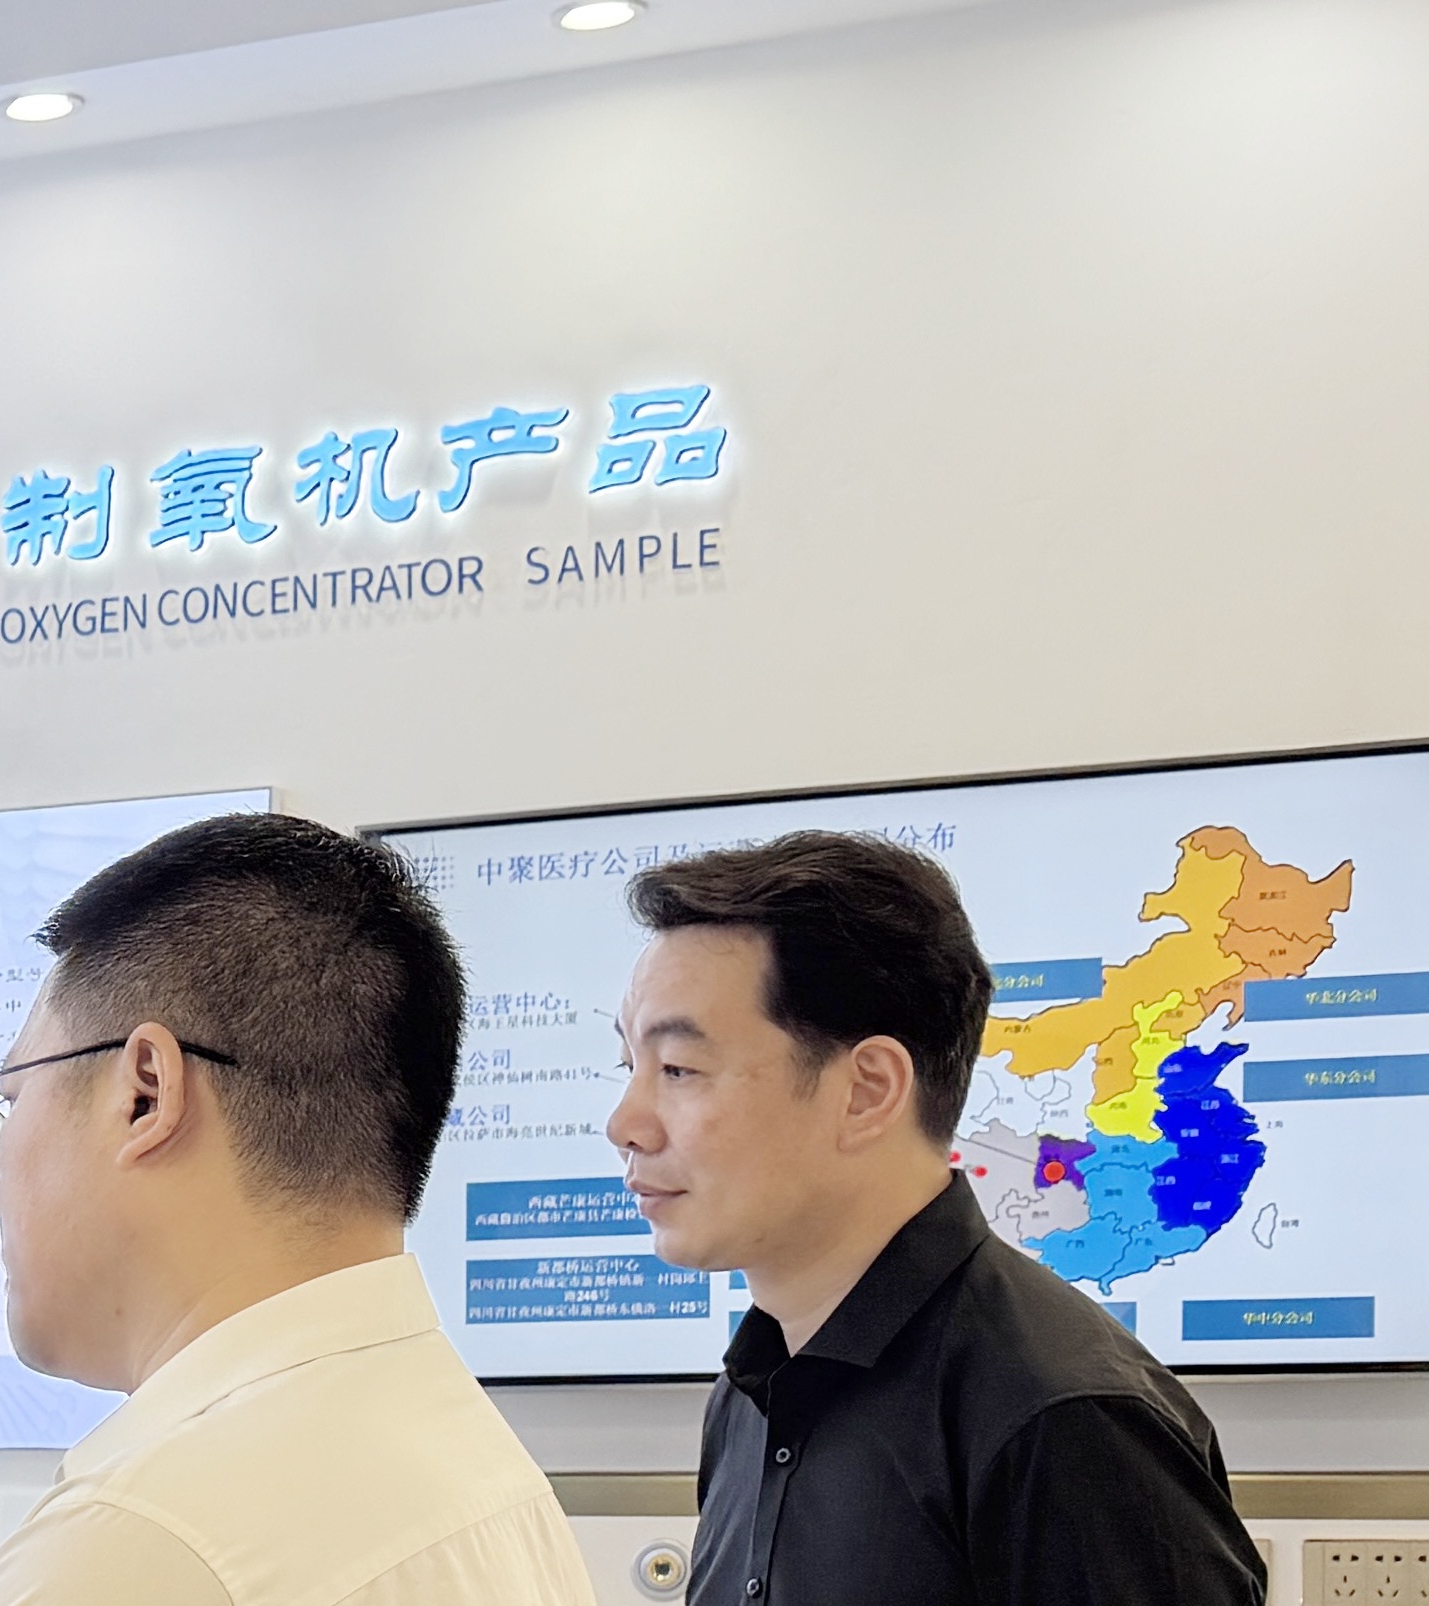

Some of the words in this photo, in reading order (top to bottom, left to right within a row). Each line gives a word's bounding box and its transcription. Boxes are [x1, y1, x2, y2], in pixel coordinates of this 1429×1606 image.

[1, 384, 727, 566] 制氧机产品
[0, 593, 147, 644] OXYGEN
[157, 555, 484, 626] CONCENTRATOR
[526, 528, 722, 585] SAMPLE
[467, 1048, 511, 1072] 公司
